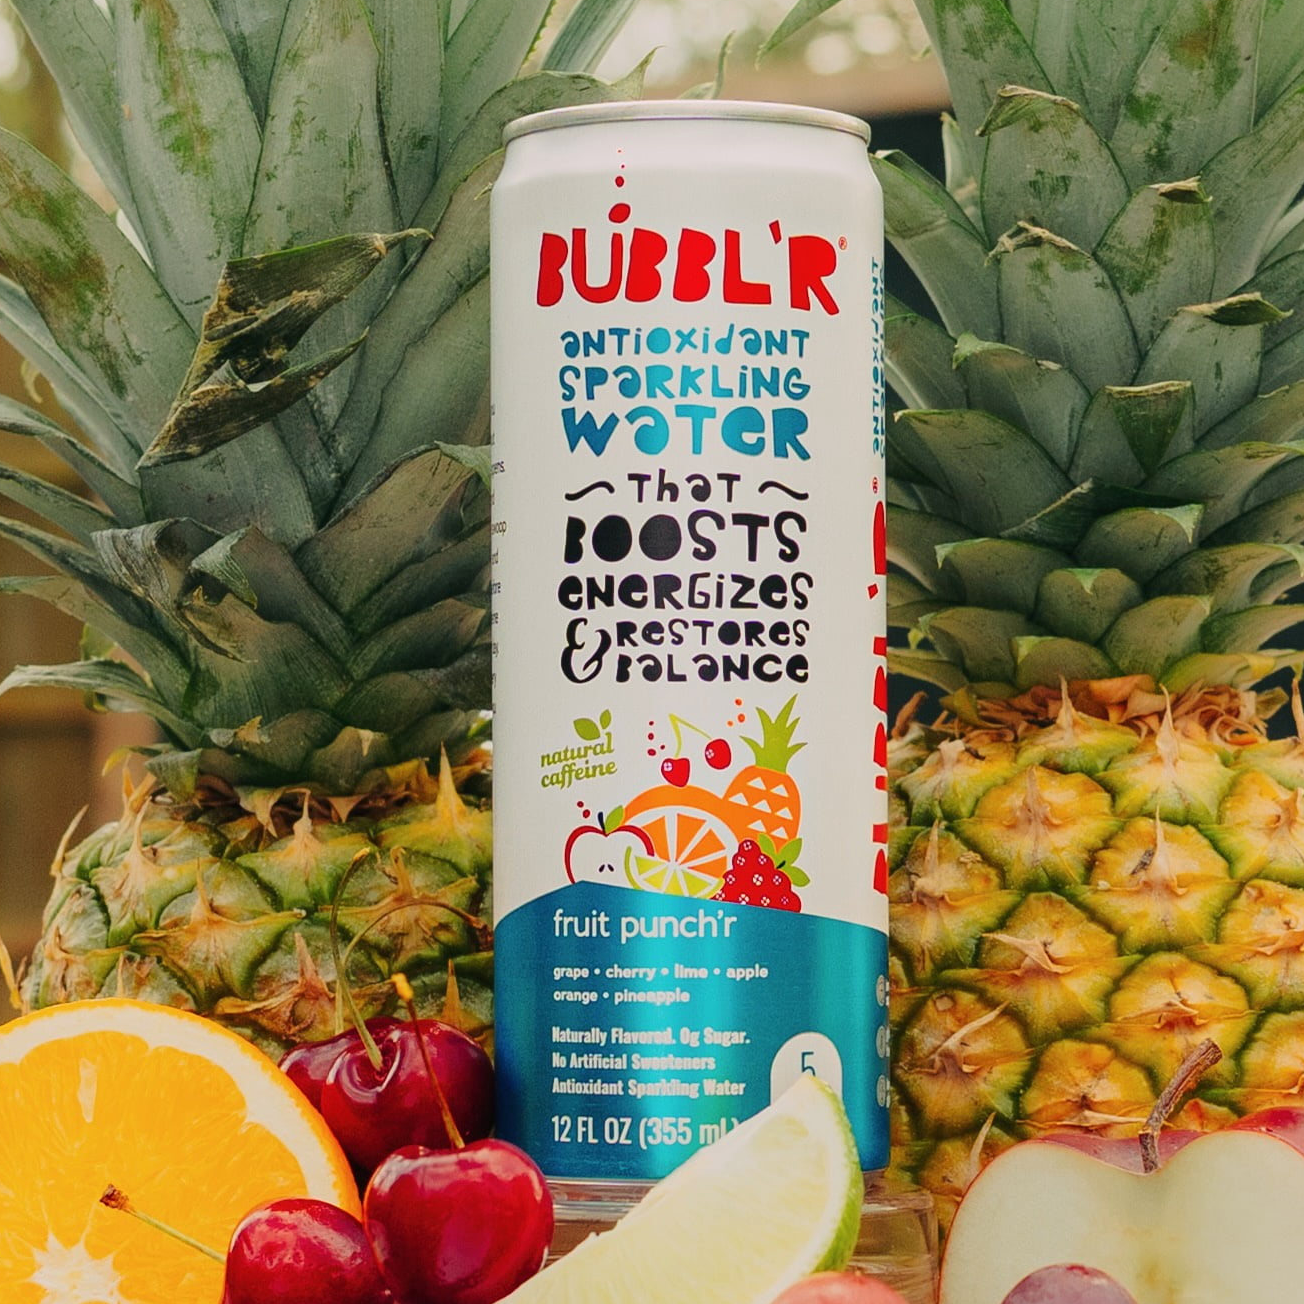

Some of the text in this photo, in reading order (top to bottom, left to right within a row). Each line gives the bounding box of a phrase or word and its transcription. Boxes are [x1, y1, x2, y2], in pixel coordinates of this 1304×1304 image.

[564, 510, 807, 564] BOOSTS
[560, 617, 612, 684] &
[540, 732, 614, 768] natural
[540, 760, 618, 790] caffeine
[553, 908, 738, 944] fruit punch'r
[553, 963, 769, 981] grape cherry lime apple
[553, 987, 691, 1006] orange pineapple
[552, 1027, 607, 1046] Naturally
[611, 1027, 676, 1044] Flavored.
[703, 1027, 751, 1047] Sugar.
[552, 1052, 716, 1070] No Artificial Sweeteners
[552, 1077, 746, 1098] Antioxidant Sparkling Water
[551, 1115, 571, 1143] 12
[577, 1116, 598, 1143] FL
[604, 1117, 632, 1144] OZ
[639, 1117, 693, 1150] (355
